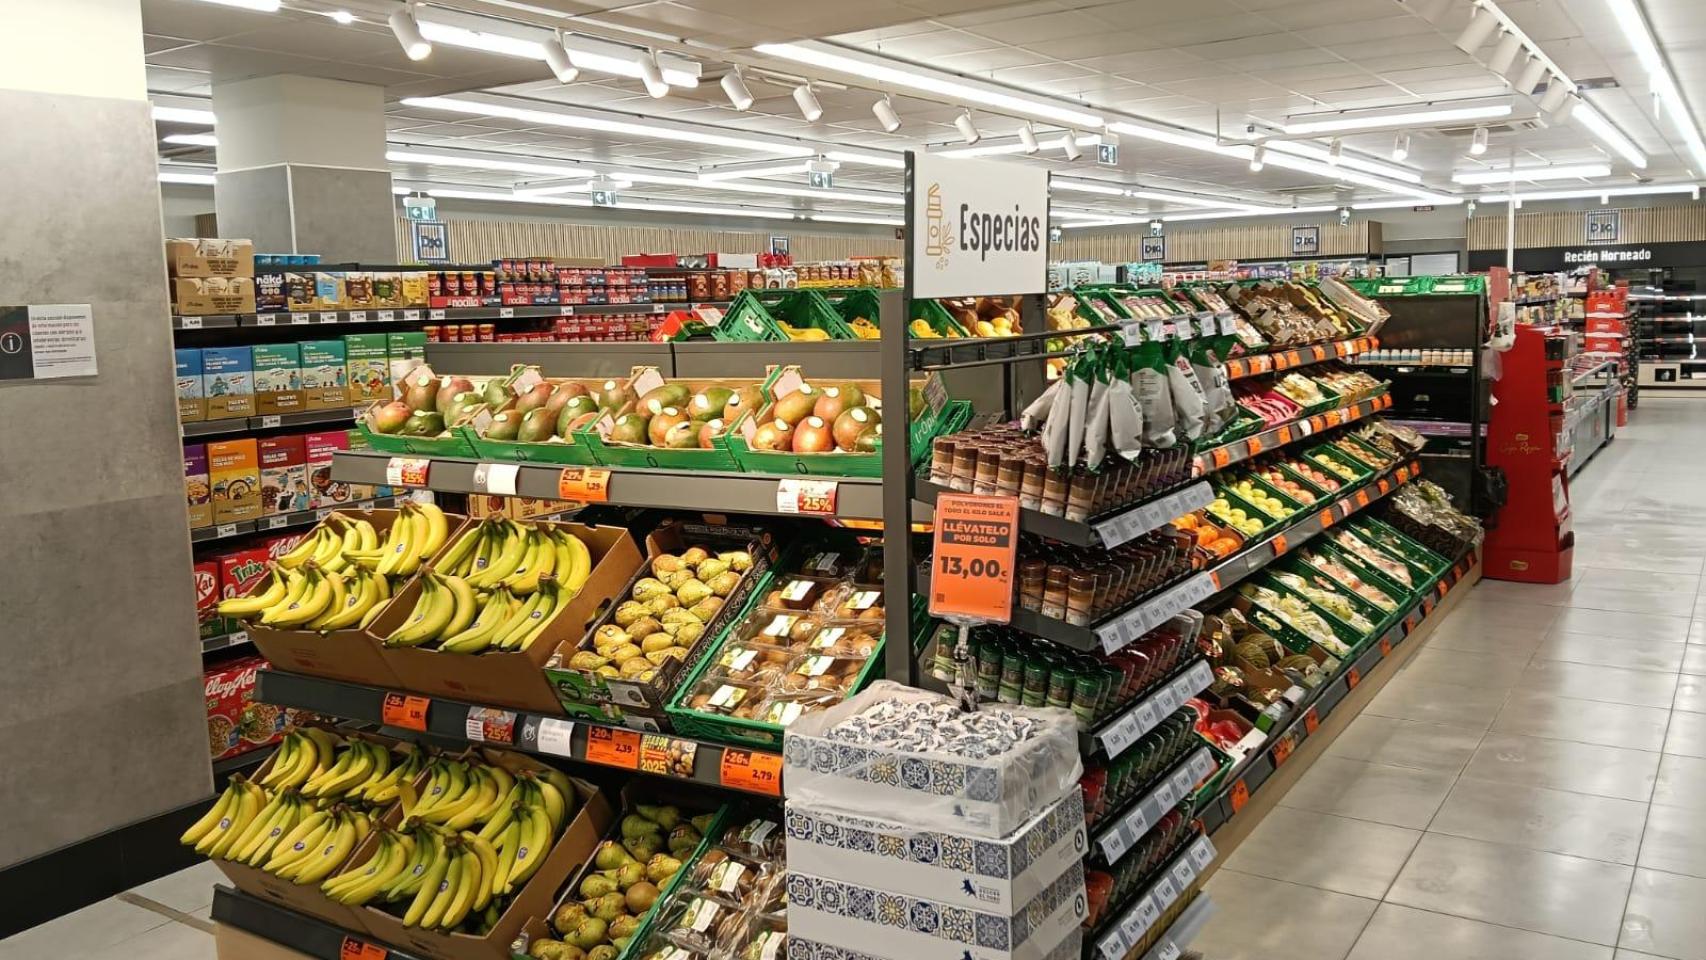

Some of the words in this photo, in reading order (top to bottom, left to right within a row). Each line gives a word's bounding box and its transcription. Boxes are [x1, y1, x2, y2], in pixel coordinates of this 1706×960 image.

[960, 203, 1040, 261] Especias
[1564, 250, 1598, 262] Recién
[1601, 248, 1651, 261] Horneado
[451, 296, 479, 307] nocilla
[799, 497, 832, 511] -25%
[944, 521, 1009, 536] LLÉVATELO
[953, 534, 972, 543] POR
[973, 535, 997, 544] SOLO
[230, 560, 263, 584] Trix
[484, 727, 512, 742] -25%
[616, 743, 632, 753] 2,39
[641, 759, 667, 774] 2025
[752, 769, 772, 781] 2,79
